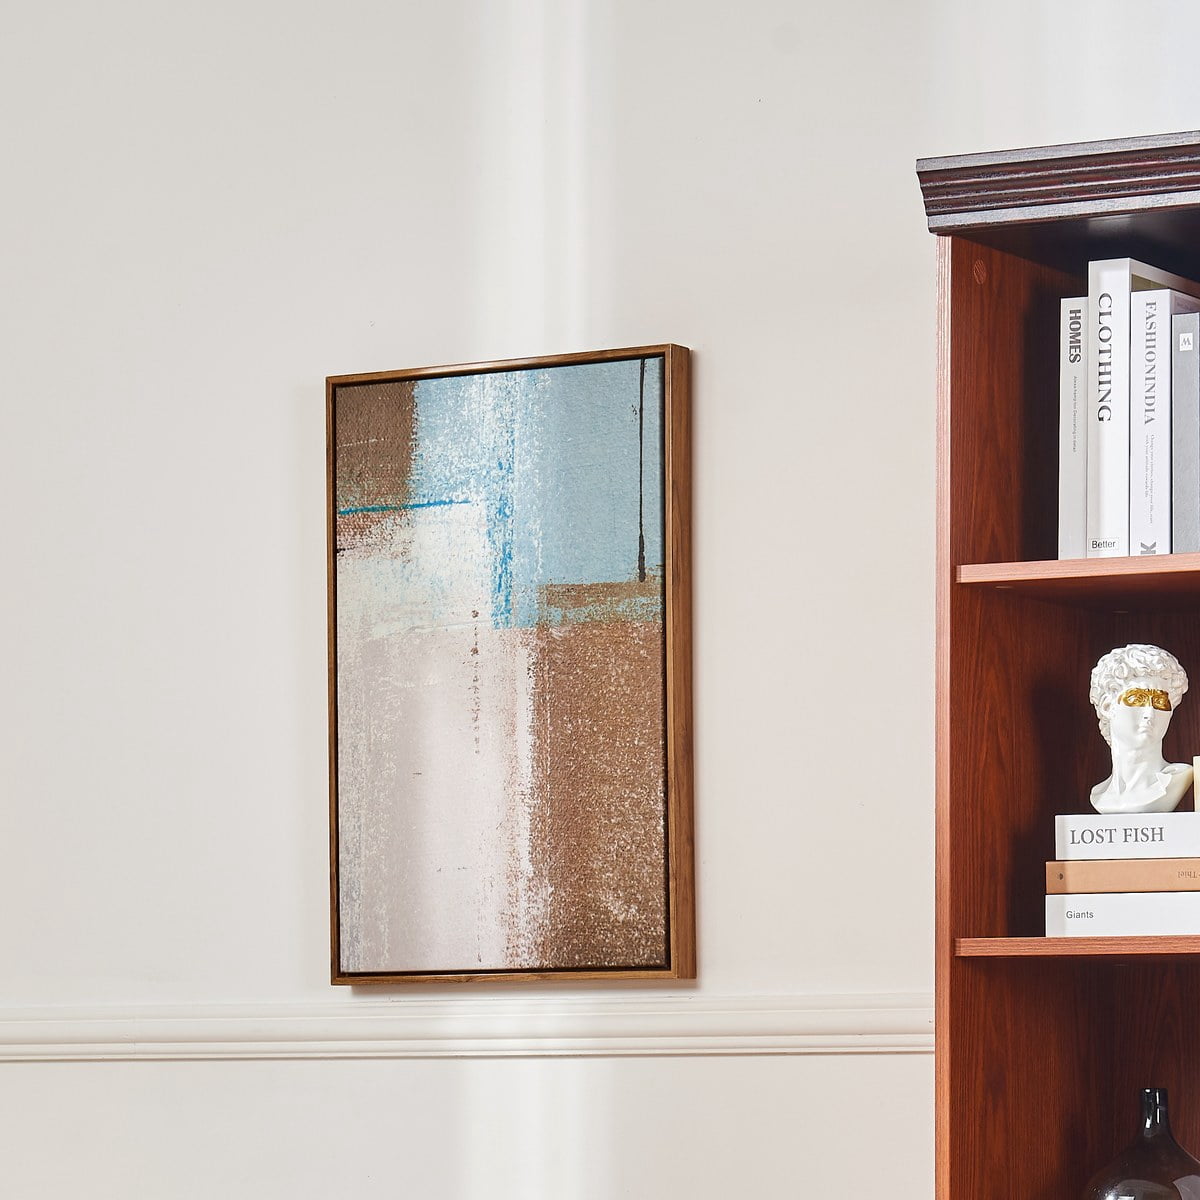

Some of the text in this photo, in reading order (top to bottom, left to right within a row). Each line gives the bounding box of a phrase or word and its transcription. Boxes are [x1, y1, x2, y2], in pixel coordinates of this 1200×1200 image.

[1068, 309, 1081, 364] HOMES
[1097, 292, 1113, 423] CLOTHING
[1144, 301, 1157, 426] FASHIONINDIA
[1091, 538, 1116, 549] Better
[1070, 826, 1165, 845] LOST FISH
[1177, 870, 1197, 879] Thiel
[1065, 910, 1095, 919] Giants
